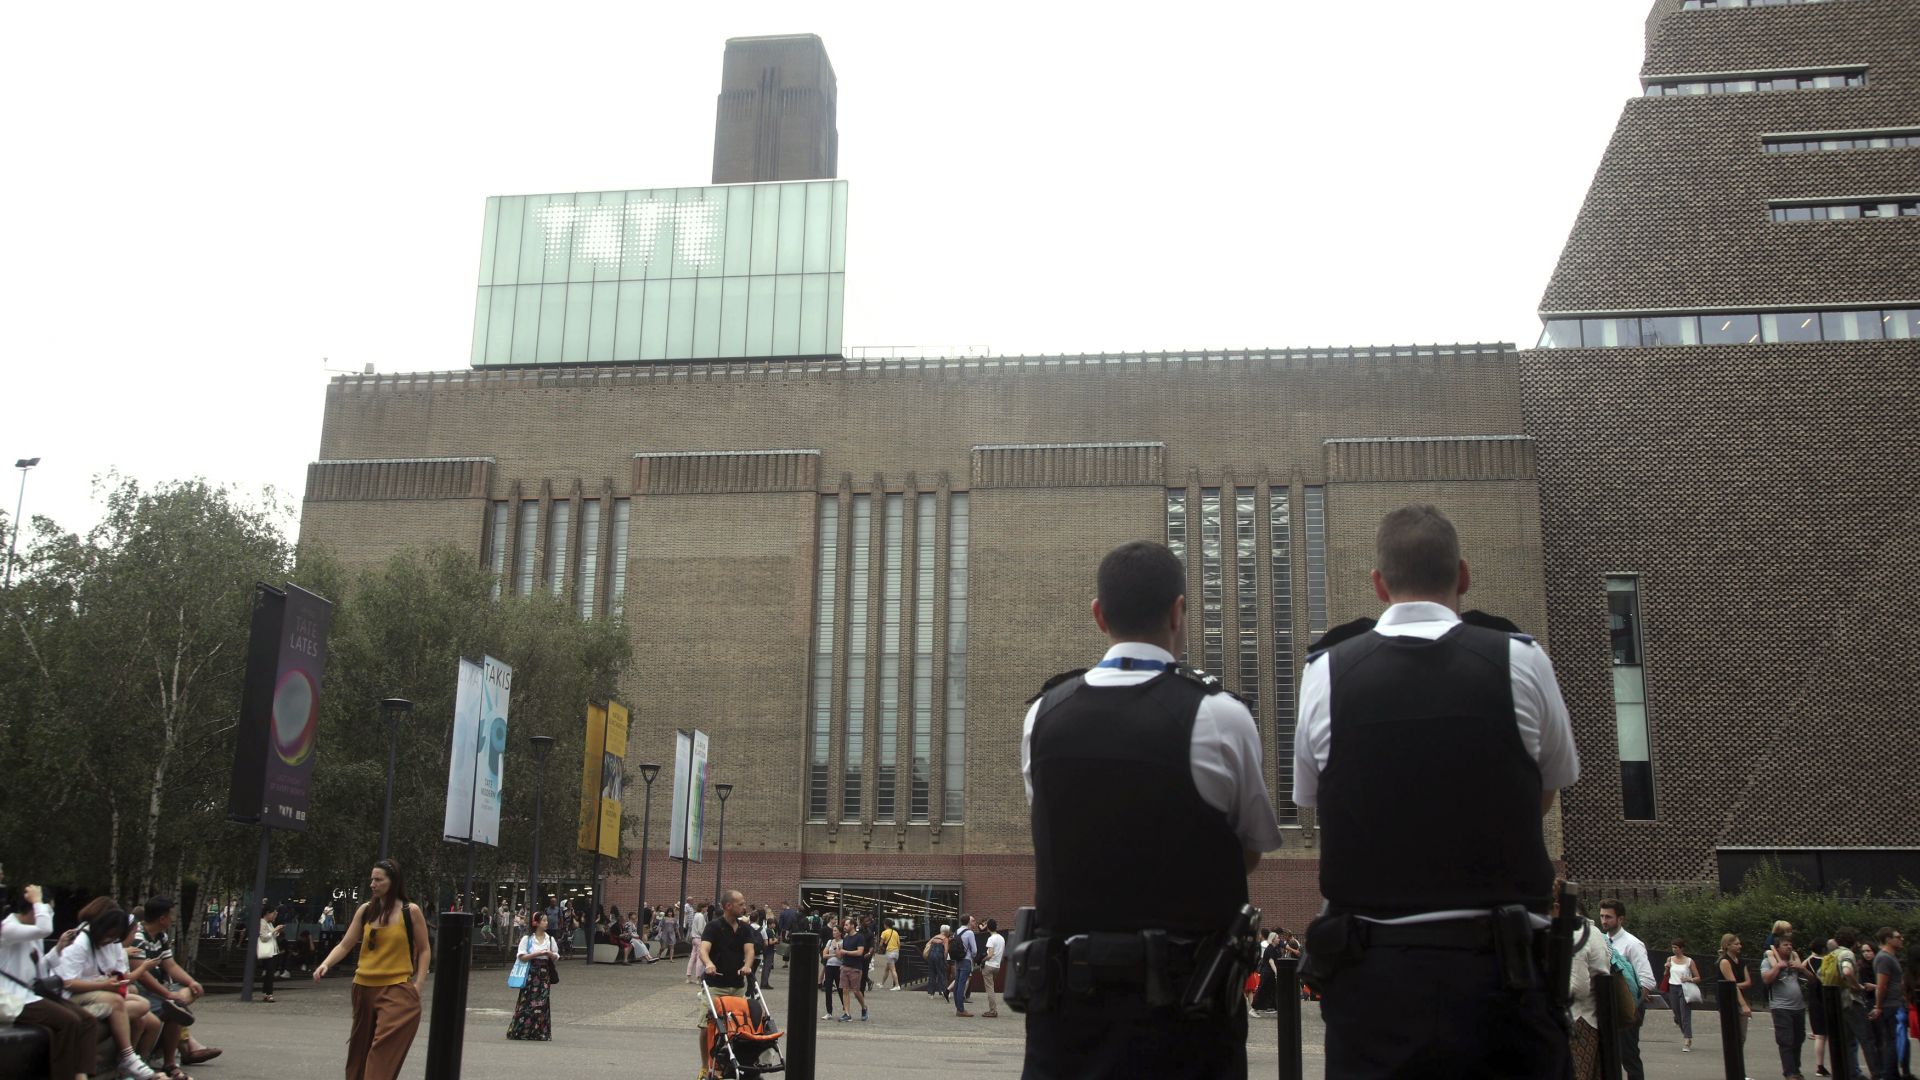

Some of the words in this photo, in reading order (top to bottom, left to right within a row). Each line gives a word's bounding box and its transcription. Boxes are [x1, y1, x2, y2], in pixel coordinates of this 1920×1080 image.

[534, 197, 720, 271] TATE
[295, 616, 319, 639] TATE
[289, 632, 318, 657] LATES
[486, 662, 511, 691] TAKIS
